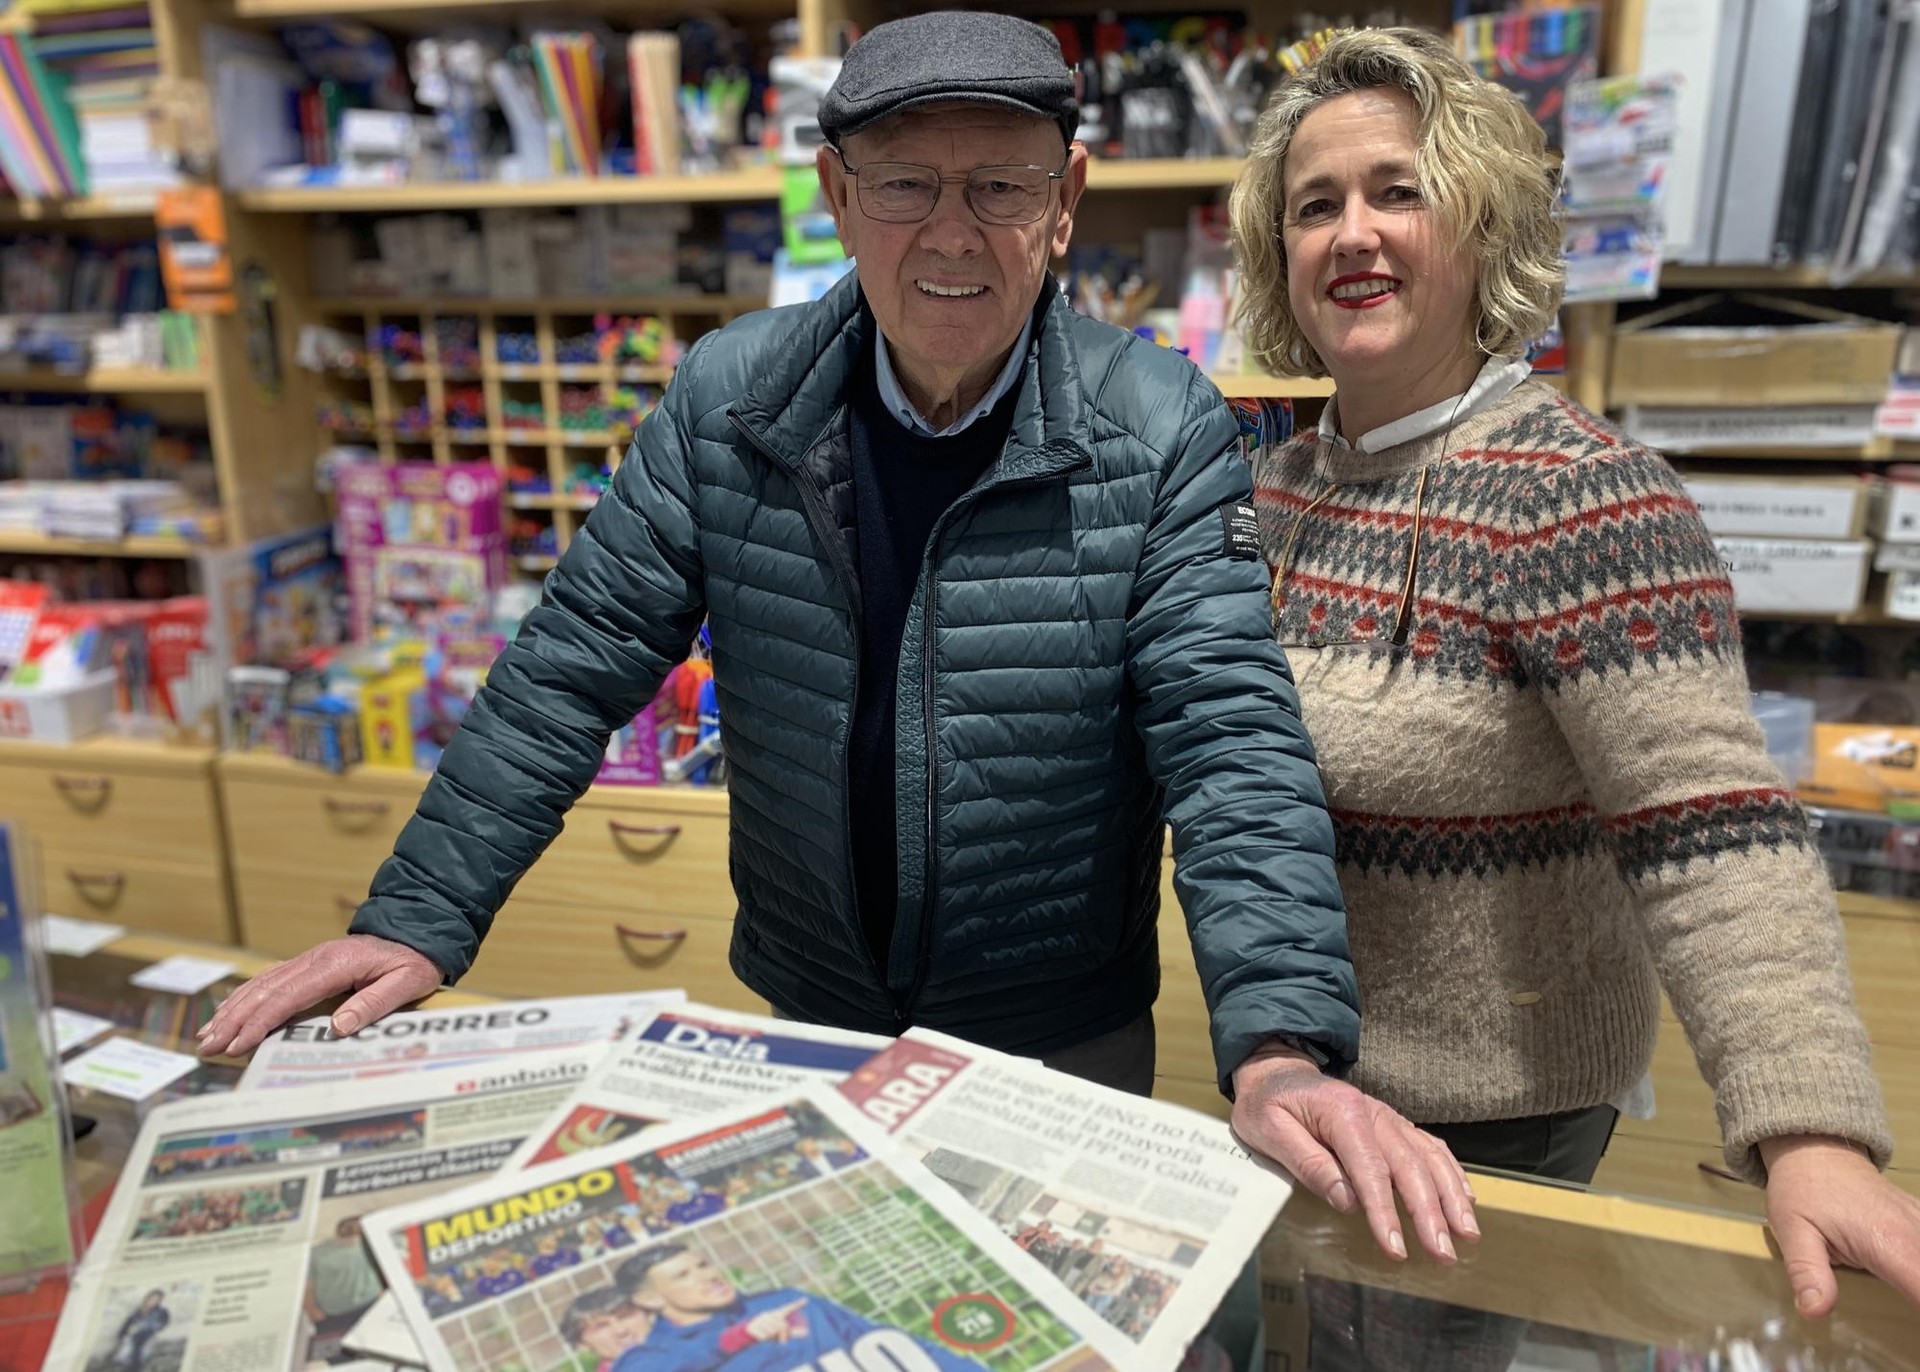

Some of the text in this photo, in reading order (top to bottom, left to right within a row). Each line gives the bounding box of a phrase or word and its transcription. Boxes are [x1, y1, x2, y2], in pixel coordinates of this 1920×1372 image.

[349, 1008, 549, 1041] CORREO
[663, 1024, 769, 1062] Deia
[862, 1062, 953, 1126] ARA
[1055, 1090, 1094, 1111] del
[1096, 1102, 1149, 1130] BNG
[1152, 1121, 1184, 1139] no
[1188, 1129, 1252, 1161] basta
[1043, 1120, 1083, 1146] del
[1083, 1133, 1118, 1155] PP
[1118, 1151, 1150, 1170] en
[1155, 1159, 1240, 1200] Galicia
[1080, 1111, 1102, 1131] la
[1107, 1122, 1205, 1166] mayoría
[424, 1169, 615, 1248] MUNDO
[428, 1201, 583, 1264] DEPORTIVO
